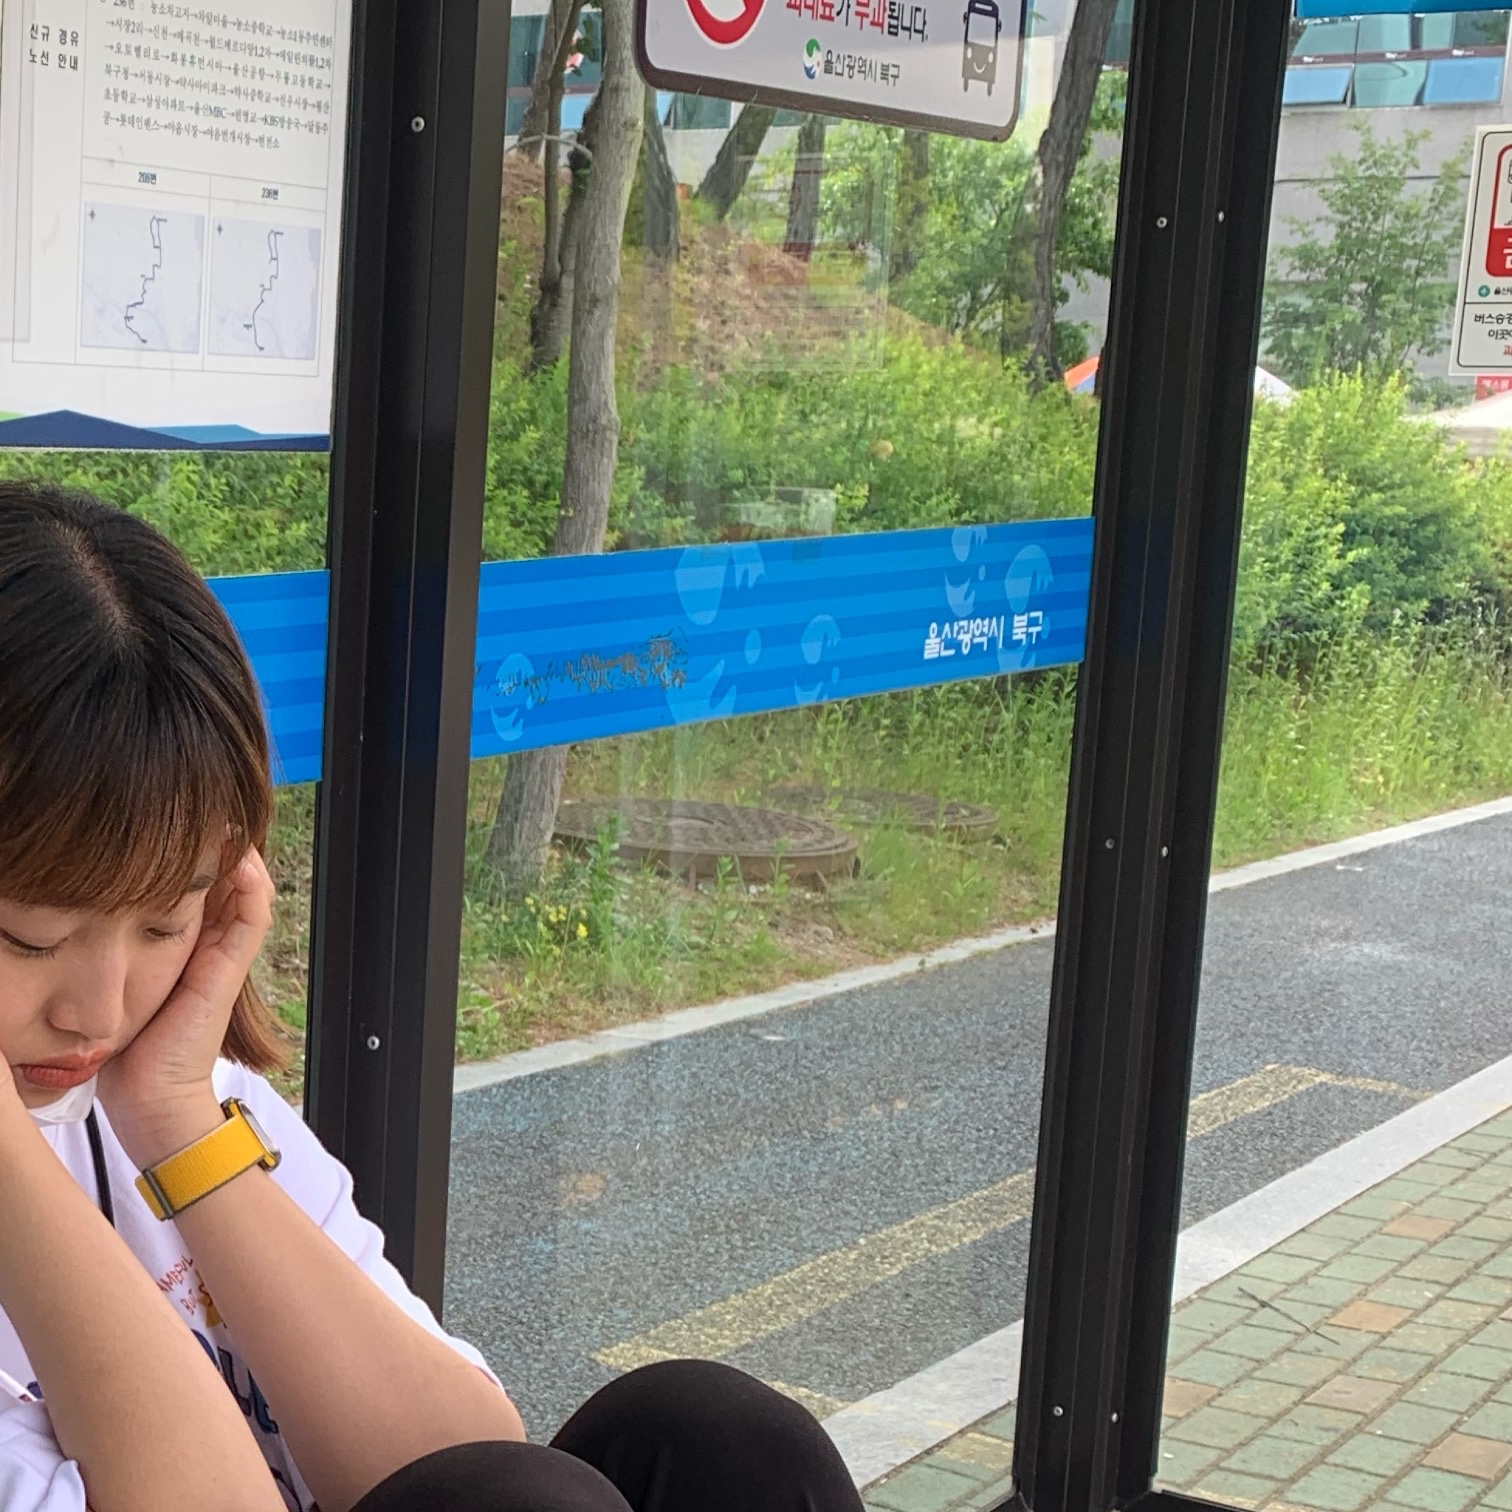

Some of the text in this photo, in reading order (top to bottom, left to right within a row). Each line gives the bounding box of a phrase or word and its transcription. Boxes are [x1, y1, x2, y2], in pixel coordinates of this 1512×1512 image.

[30, 23, 79, 47] 신규 경유
[855, 0, 928, 42] 부과됩니다.
[29, 48, 78, 71] 노선 안내
[824, 50, 900, 86] 울산광역시 북구
[1488, 329, 1512, 341] 이곳
[924, 611, 1043, 659] 울산광역시 북구
